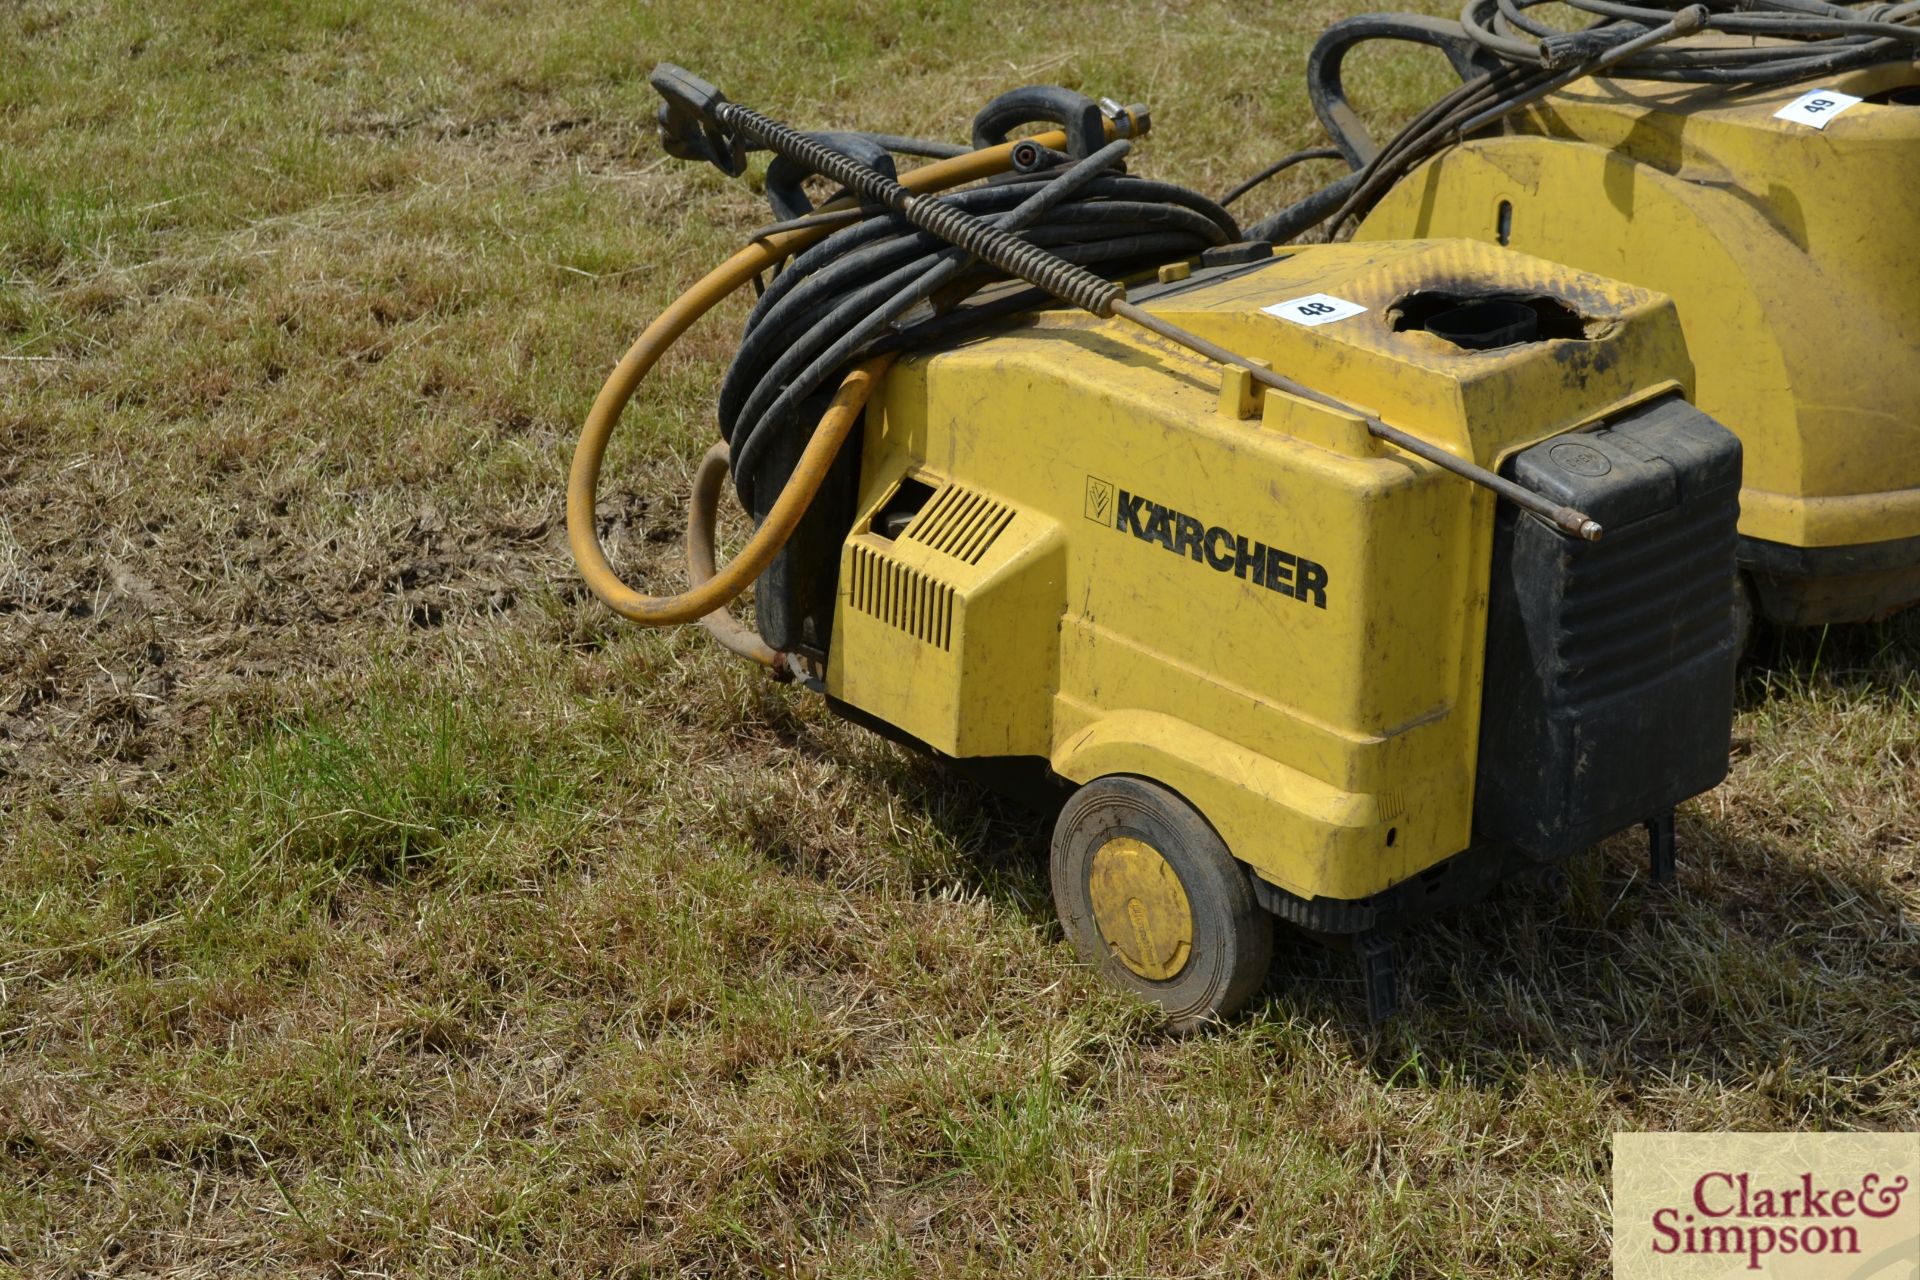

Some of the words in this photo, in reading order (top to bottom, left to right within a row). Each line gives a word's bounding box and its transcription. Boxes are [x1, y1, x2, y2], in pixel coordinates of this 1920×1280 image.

[1804, 99, 1836, 113] 49
[1297, 302, 1336, 316] 48
[1116, 488, 1328, 610] KÄRCHER
